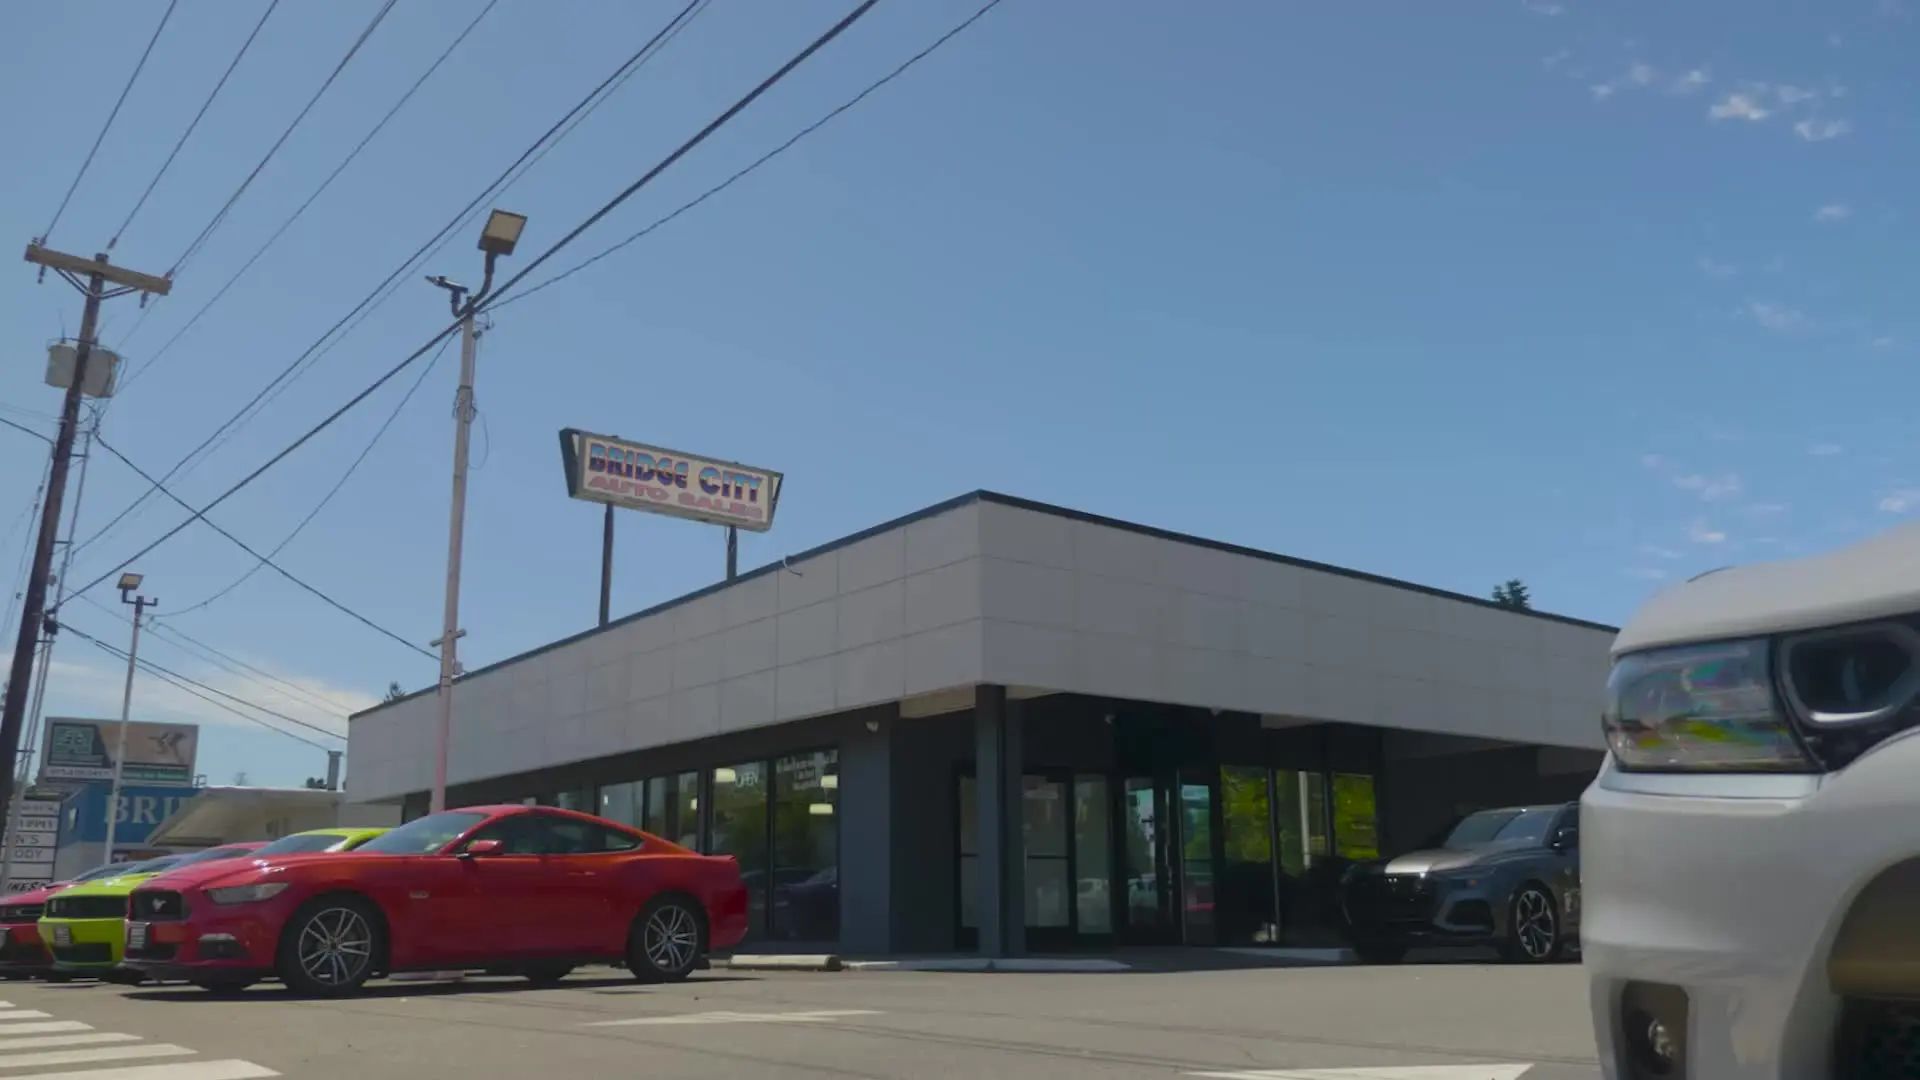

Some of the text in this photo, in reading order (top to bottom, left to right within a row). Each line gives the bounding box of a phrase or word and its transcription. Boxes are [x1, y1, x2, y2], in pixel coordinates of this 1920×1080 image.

[589, 443, 763, 504] BRIDGE CITY
[588, 475, 762, 519] AUTO SALES
[104, 795, 180, 824] BRI
